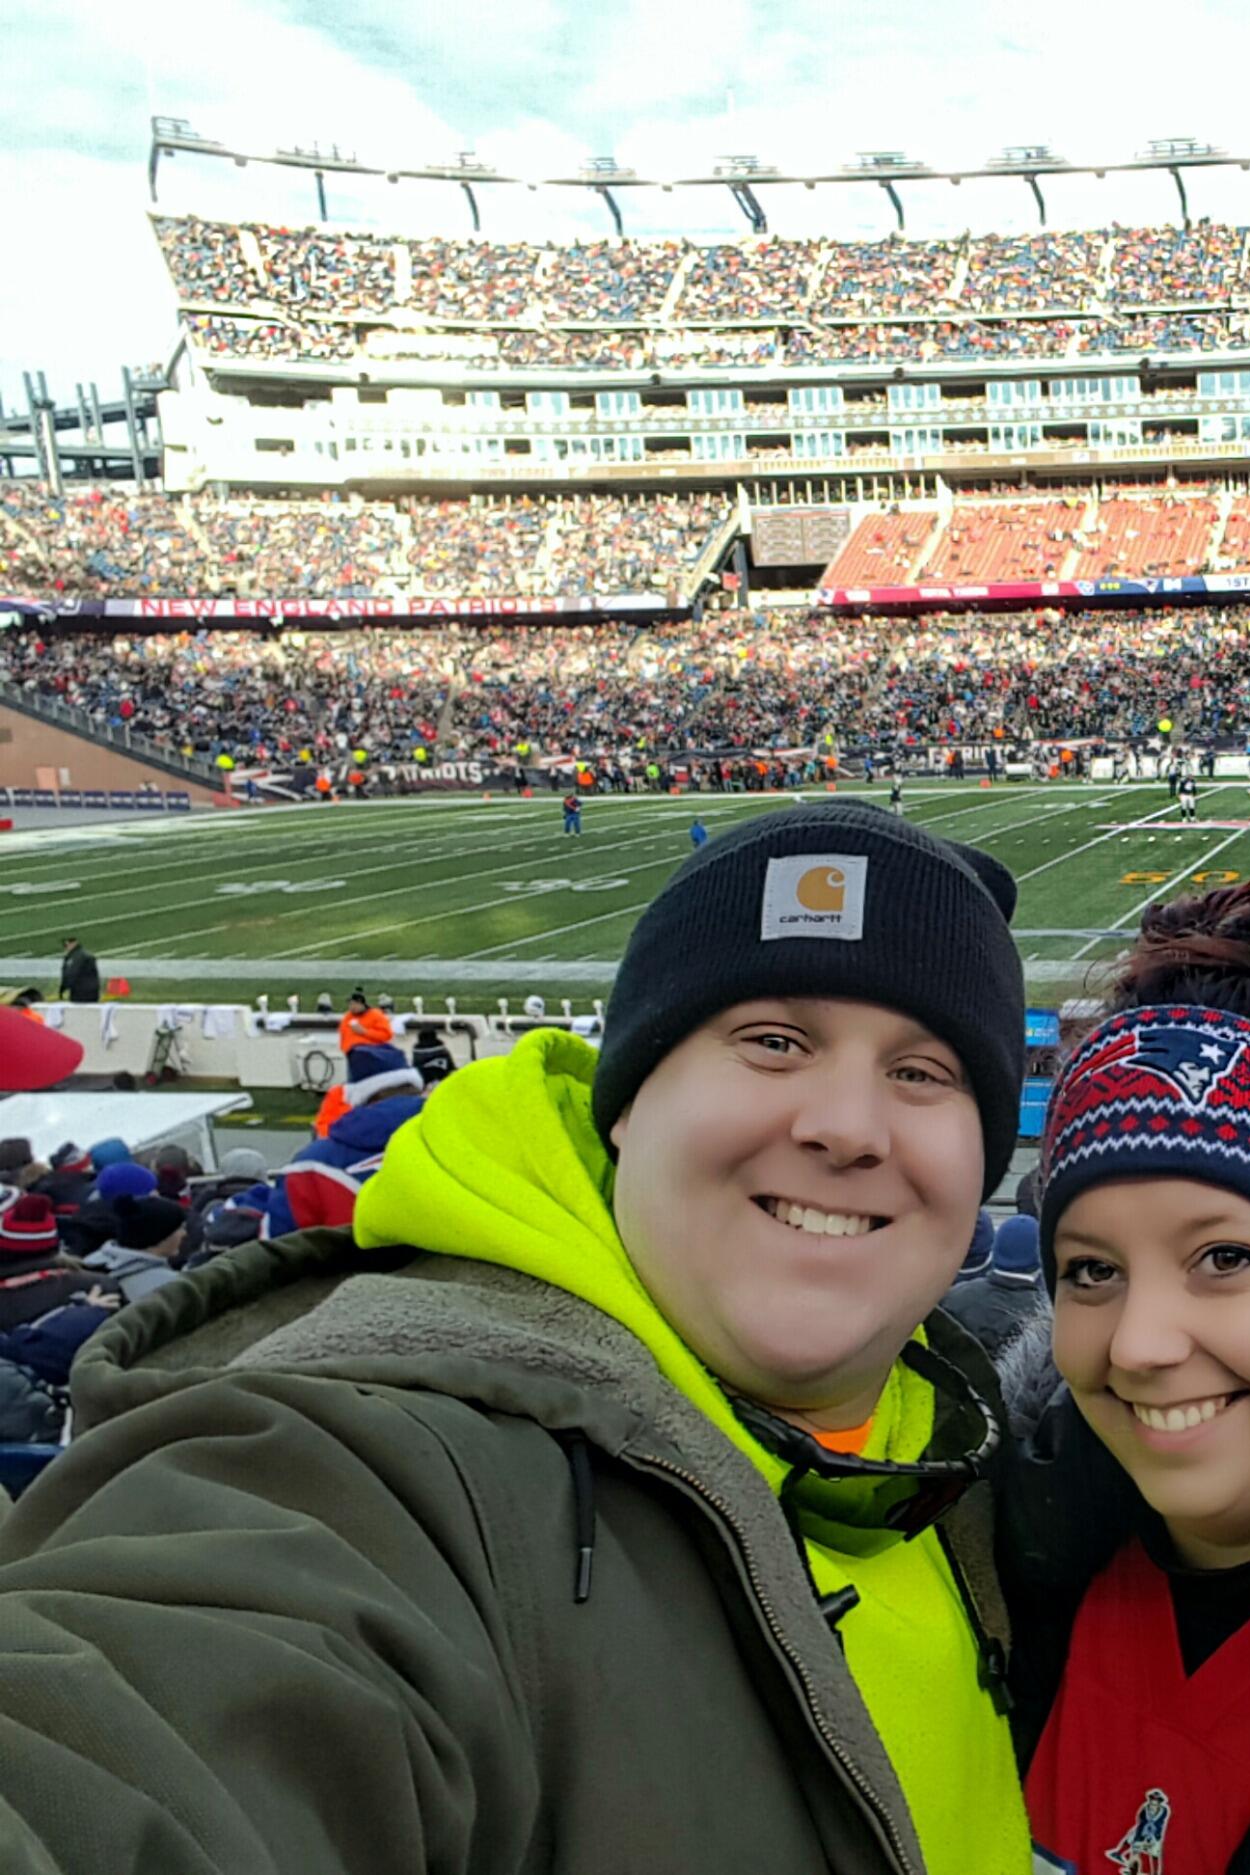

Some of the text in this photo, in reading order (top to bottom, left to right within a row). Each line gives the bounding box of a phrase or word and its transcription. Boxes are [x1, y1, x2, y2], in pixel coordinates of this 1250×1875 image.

[141, 596, 557, 617] NEW ENGLAND PATRIOTS
[1119, 869, 1241, 885] 50
[779, 913, 842, 924] carhartt
